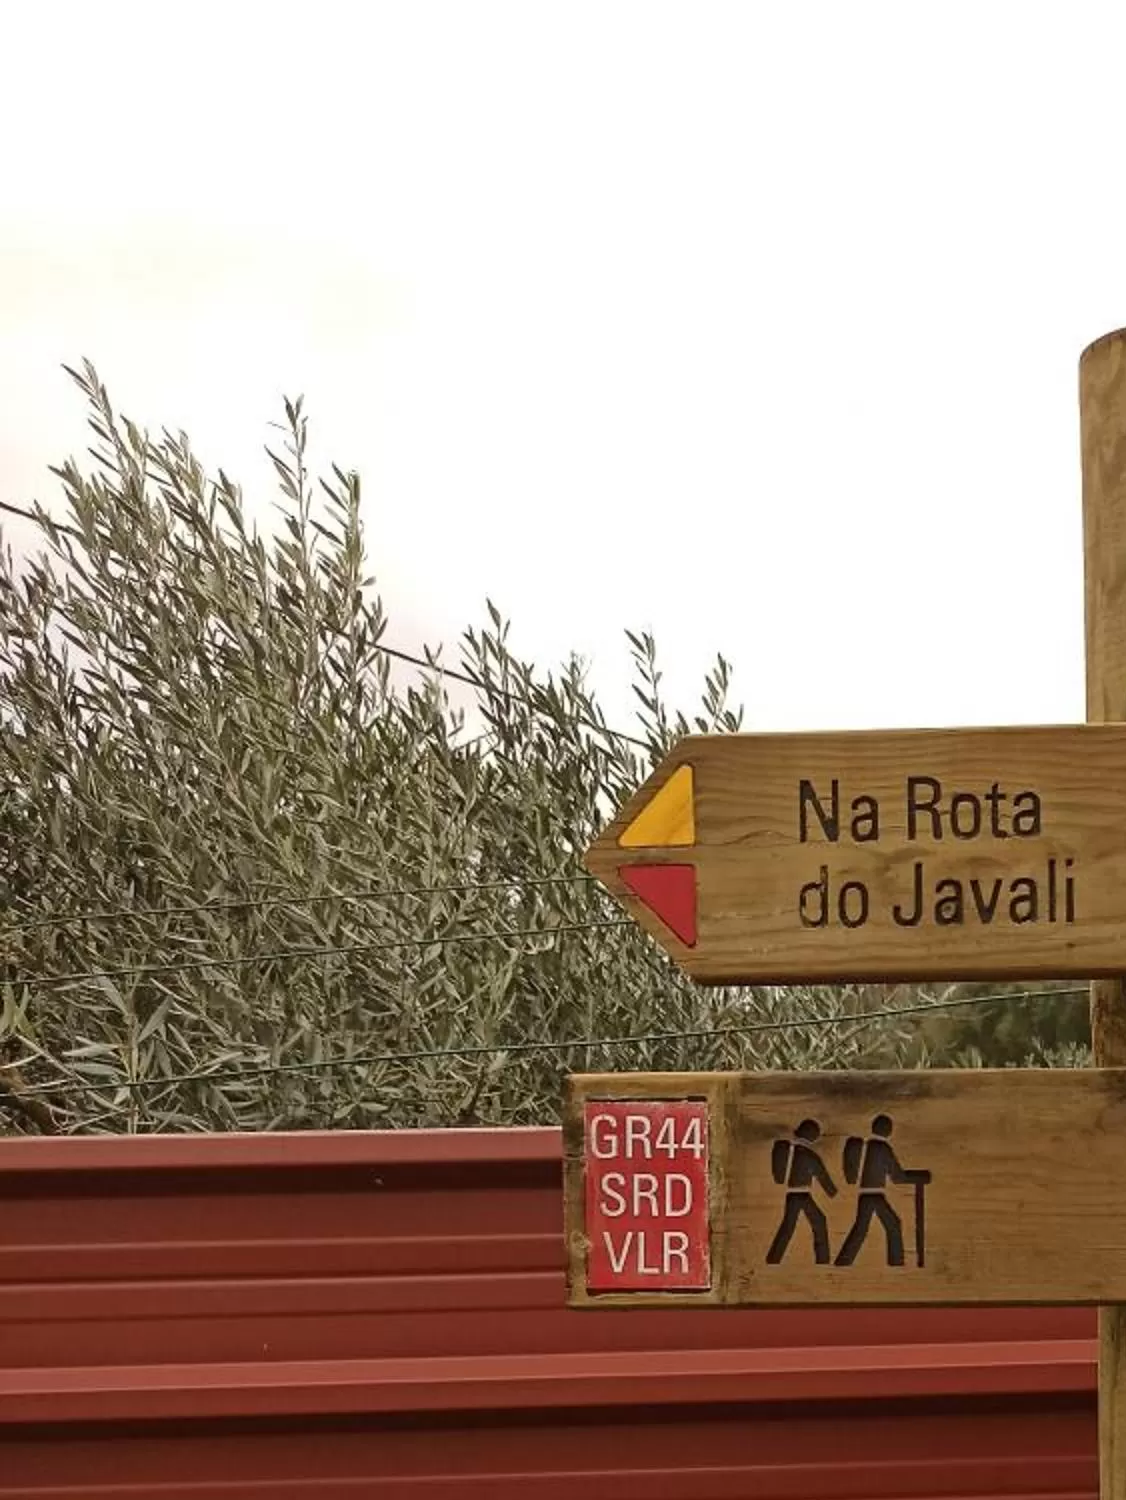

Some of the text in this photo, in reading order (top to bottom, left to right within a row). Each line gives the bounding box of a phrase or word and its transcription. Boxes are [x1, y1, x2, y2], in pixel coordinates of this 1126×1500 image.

[798, 775, 1042, 842] Na Rota
[799, 858, 1075, 929] do Javali
[590, 1113, 705, 1160] GR44
[600, 1171, 693, 1218] SRD
[602, 1230, 690, 1275] VLR
